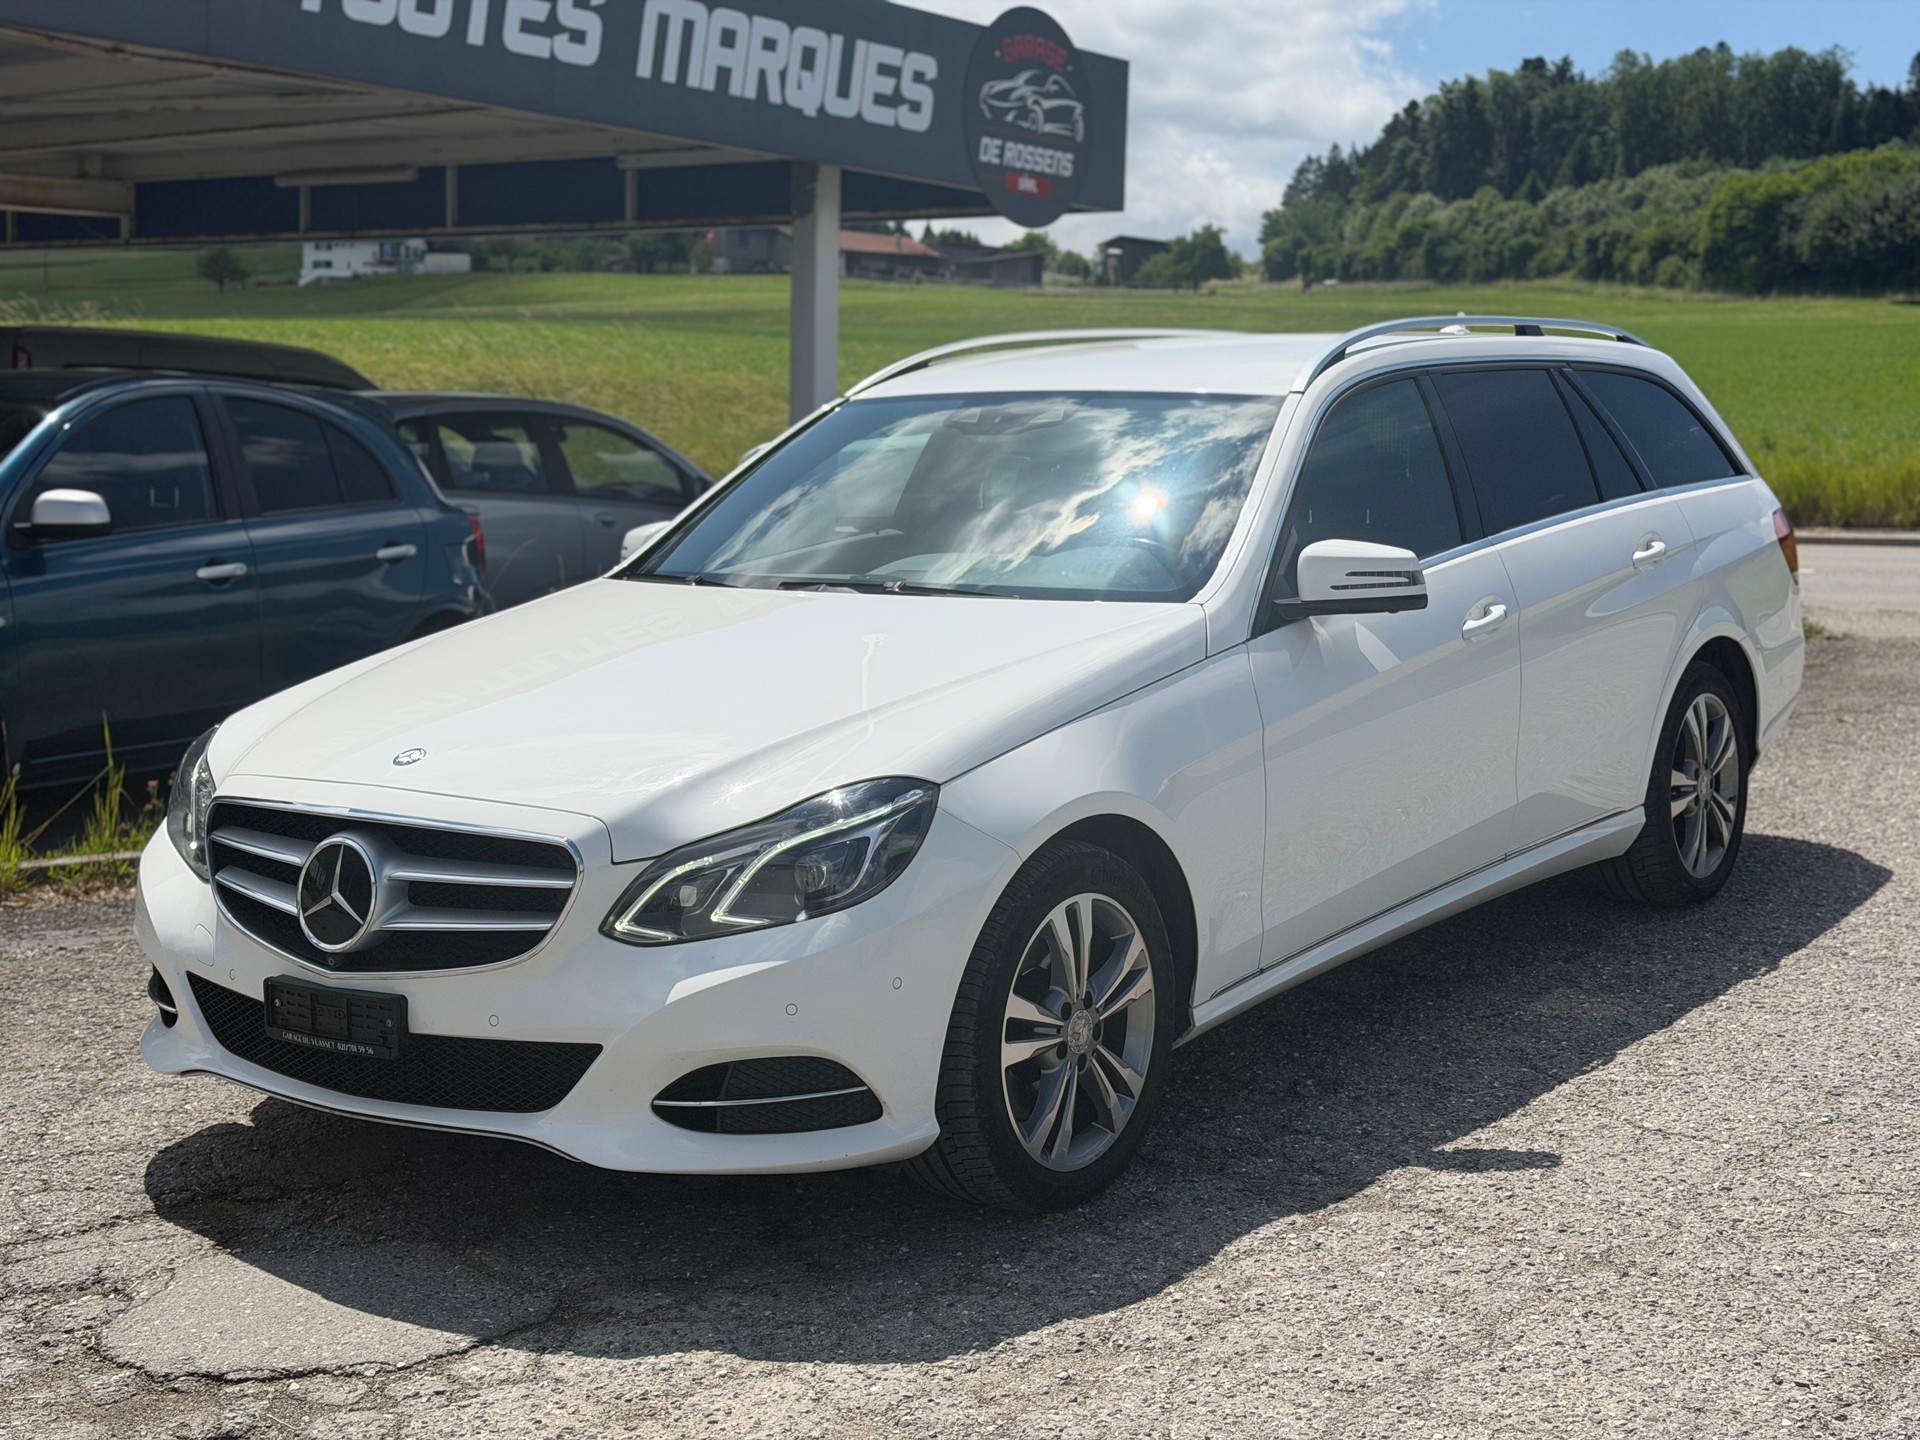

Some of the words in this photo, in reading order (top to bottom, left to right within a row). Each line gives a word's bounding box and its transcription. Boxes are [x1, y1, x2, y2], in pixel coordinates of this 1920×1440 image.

[300, 0, 604, 67] TES
[635, 0, 938, 132] MARQUES
[1002, 34, 1068, 73] GARAGE
[978, 136, 1003, 164] DE
[1003, 141, 1075, 178] ROSSENS
[282, 1031, 302, 1044] GARAGE
